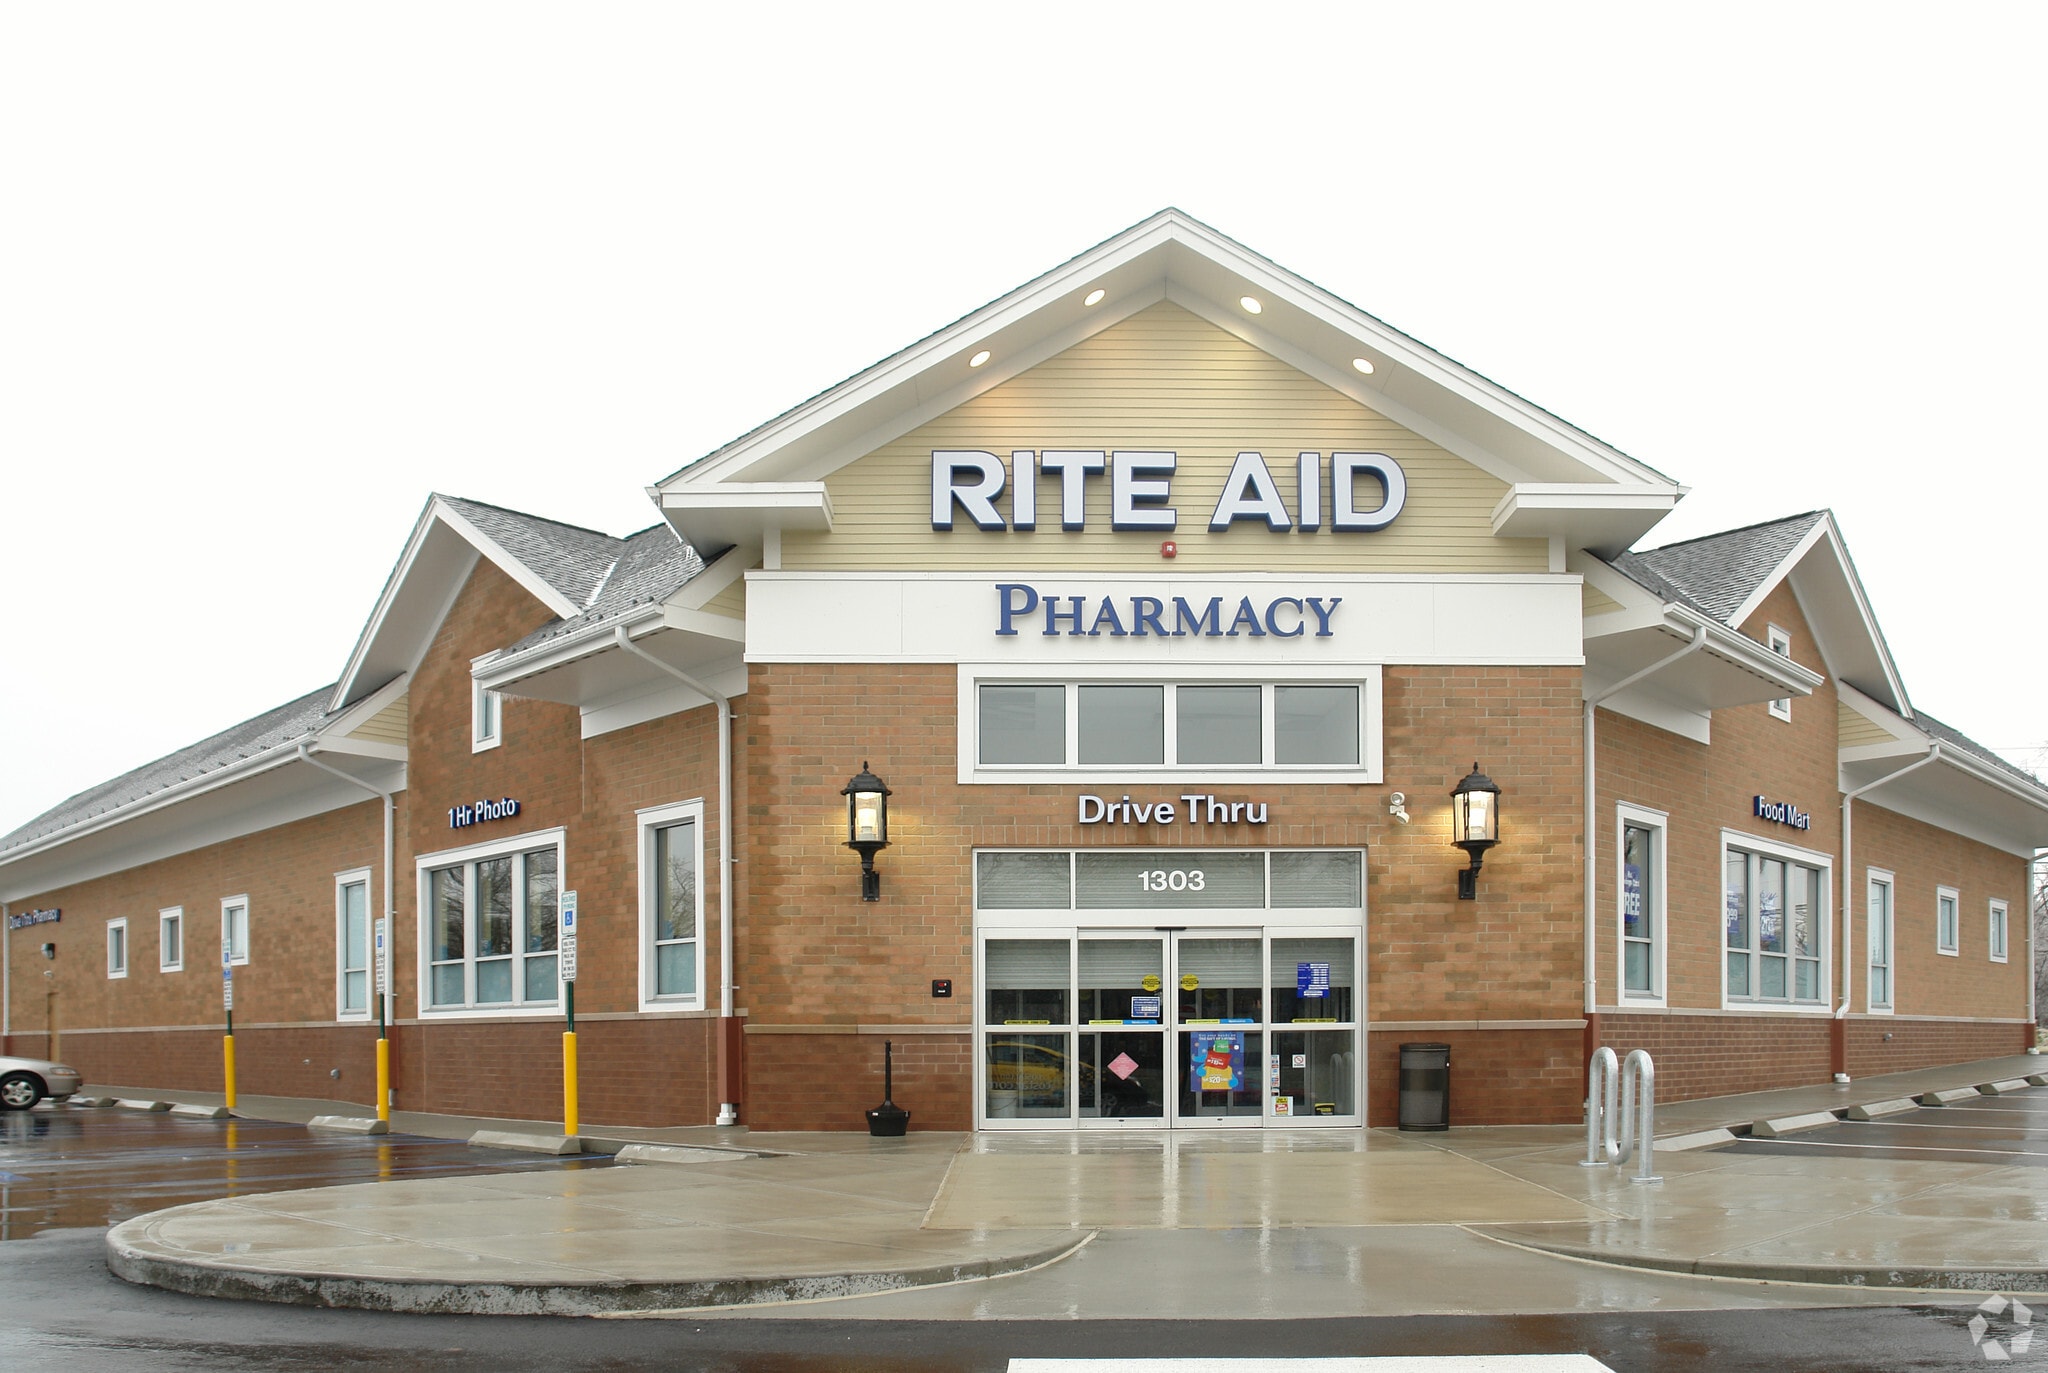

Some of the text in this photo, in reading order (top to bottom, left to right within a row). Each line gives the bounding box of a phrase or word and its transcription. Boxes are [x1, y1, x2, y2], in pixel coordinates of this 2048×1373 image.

[931, 449, 1408, 533] RITE AID
[995, 584, 1342, 638] PHARMACY
[447, 797, 519, 829] 1 Hr Photo
[1078, 794, 1268, 825] Drive Thru
[1755, 795, 1811, 830] Food Mart
[1138, 870, 1206, 891] 1303
